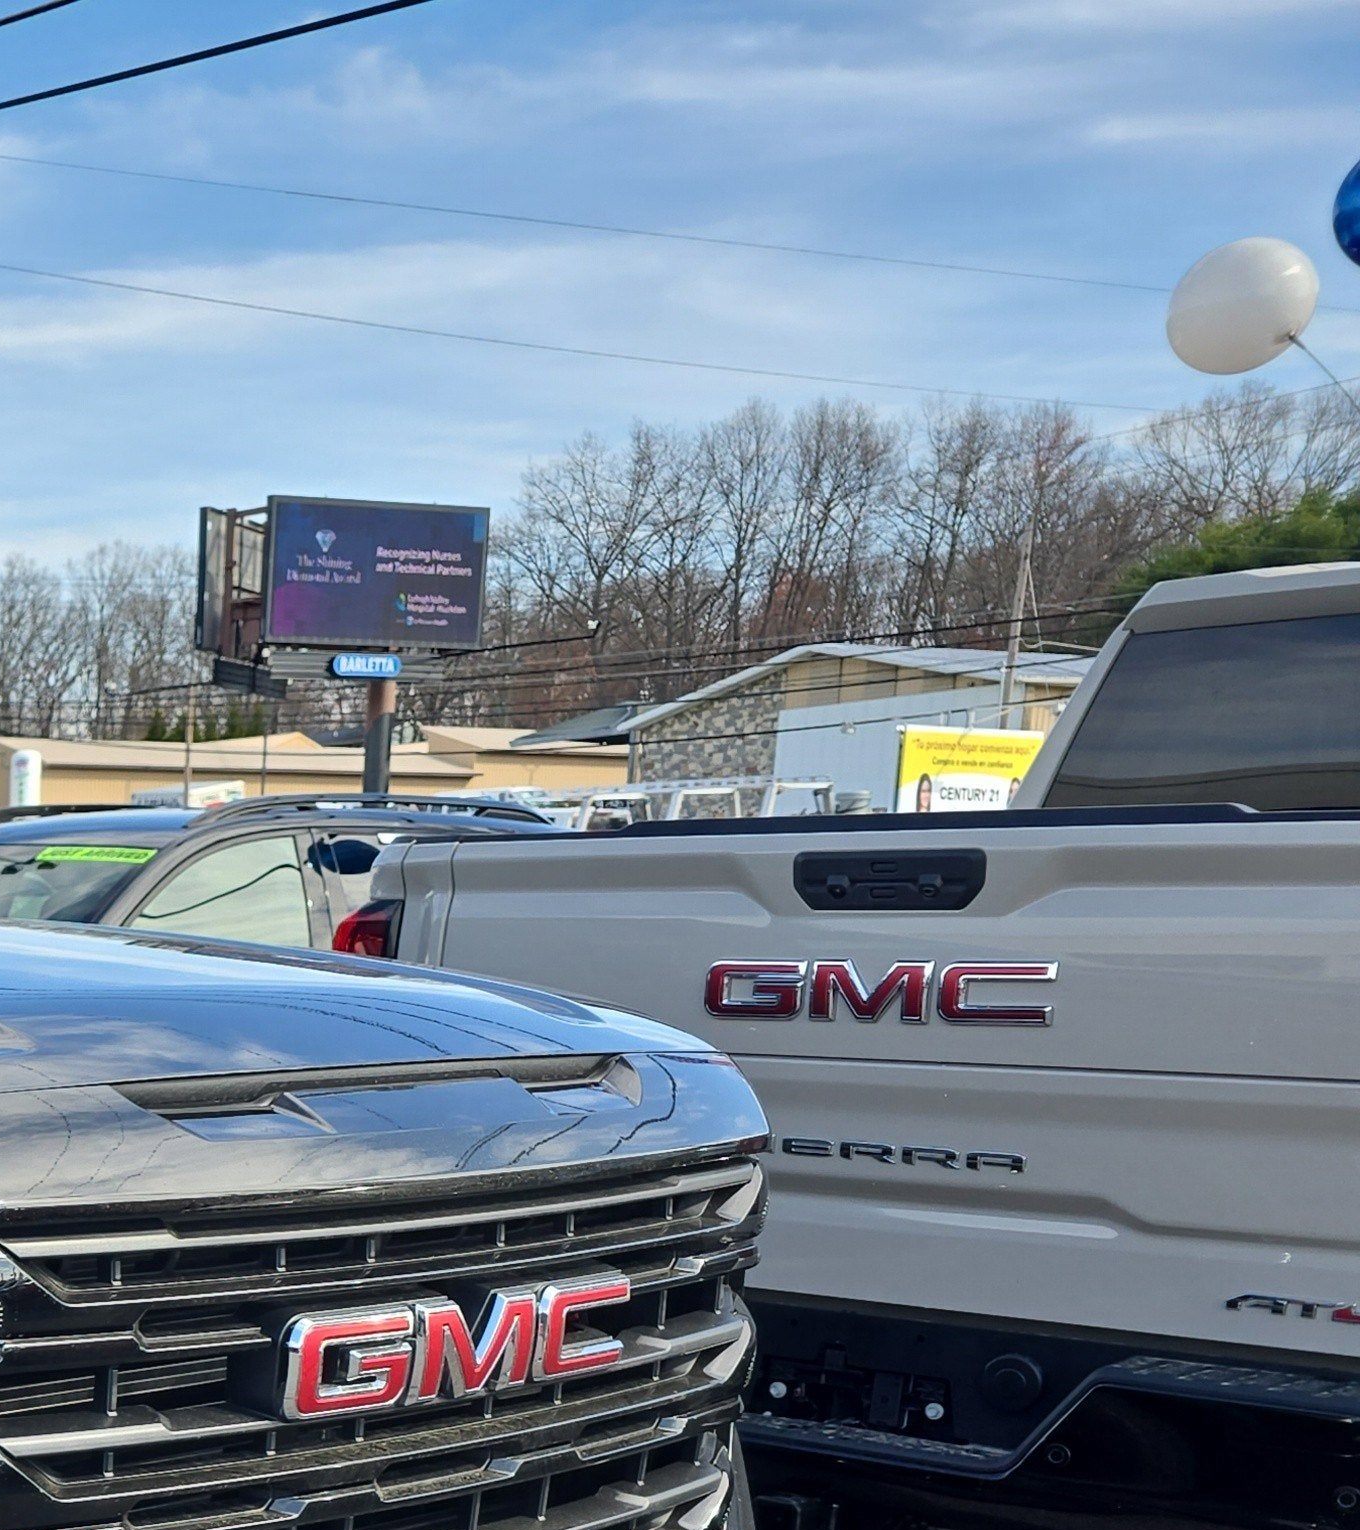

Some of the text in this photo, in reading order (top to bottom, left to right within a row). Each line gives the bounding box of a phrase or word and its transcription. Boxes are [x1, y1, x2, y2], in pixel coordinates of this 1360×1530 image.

[940, 787, 1000, 802] CENTURY 21
[704, 958, 1060, 1028] GMC
[281, 1272, 632, 1422] GMC
